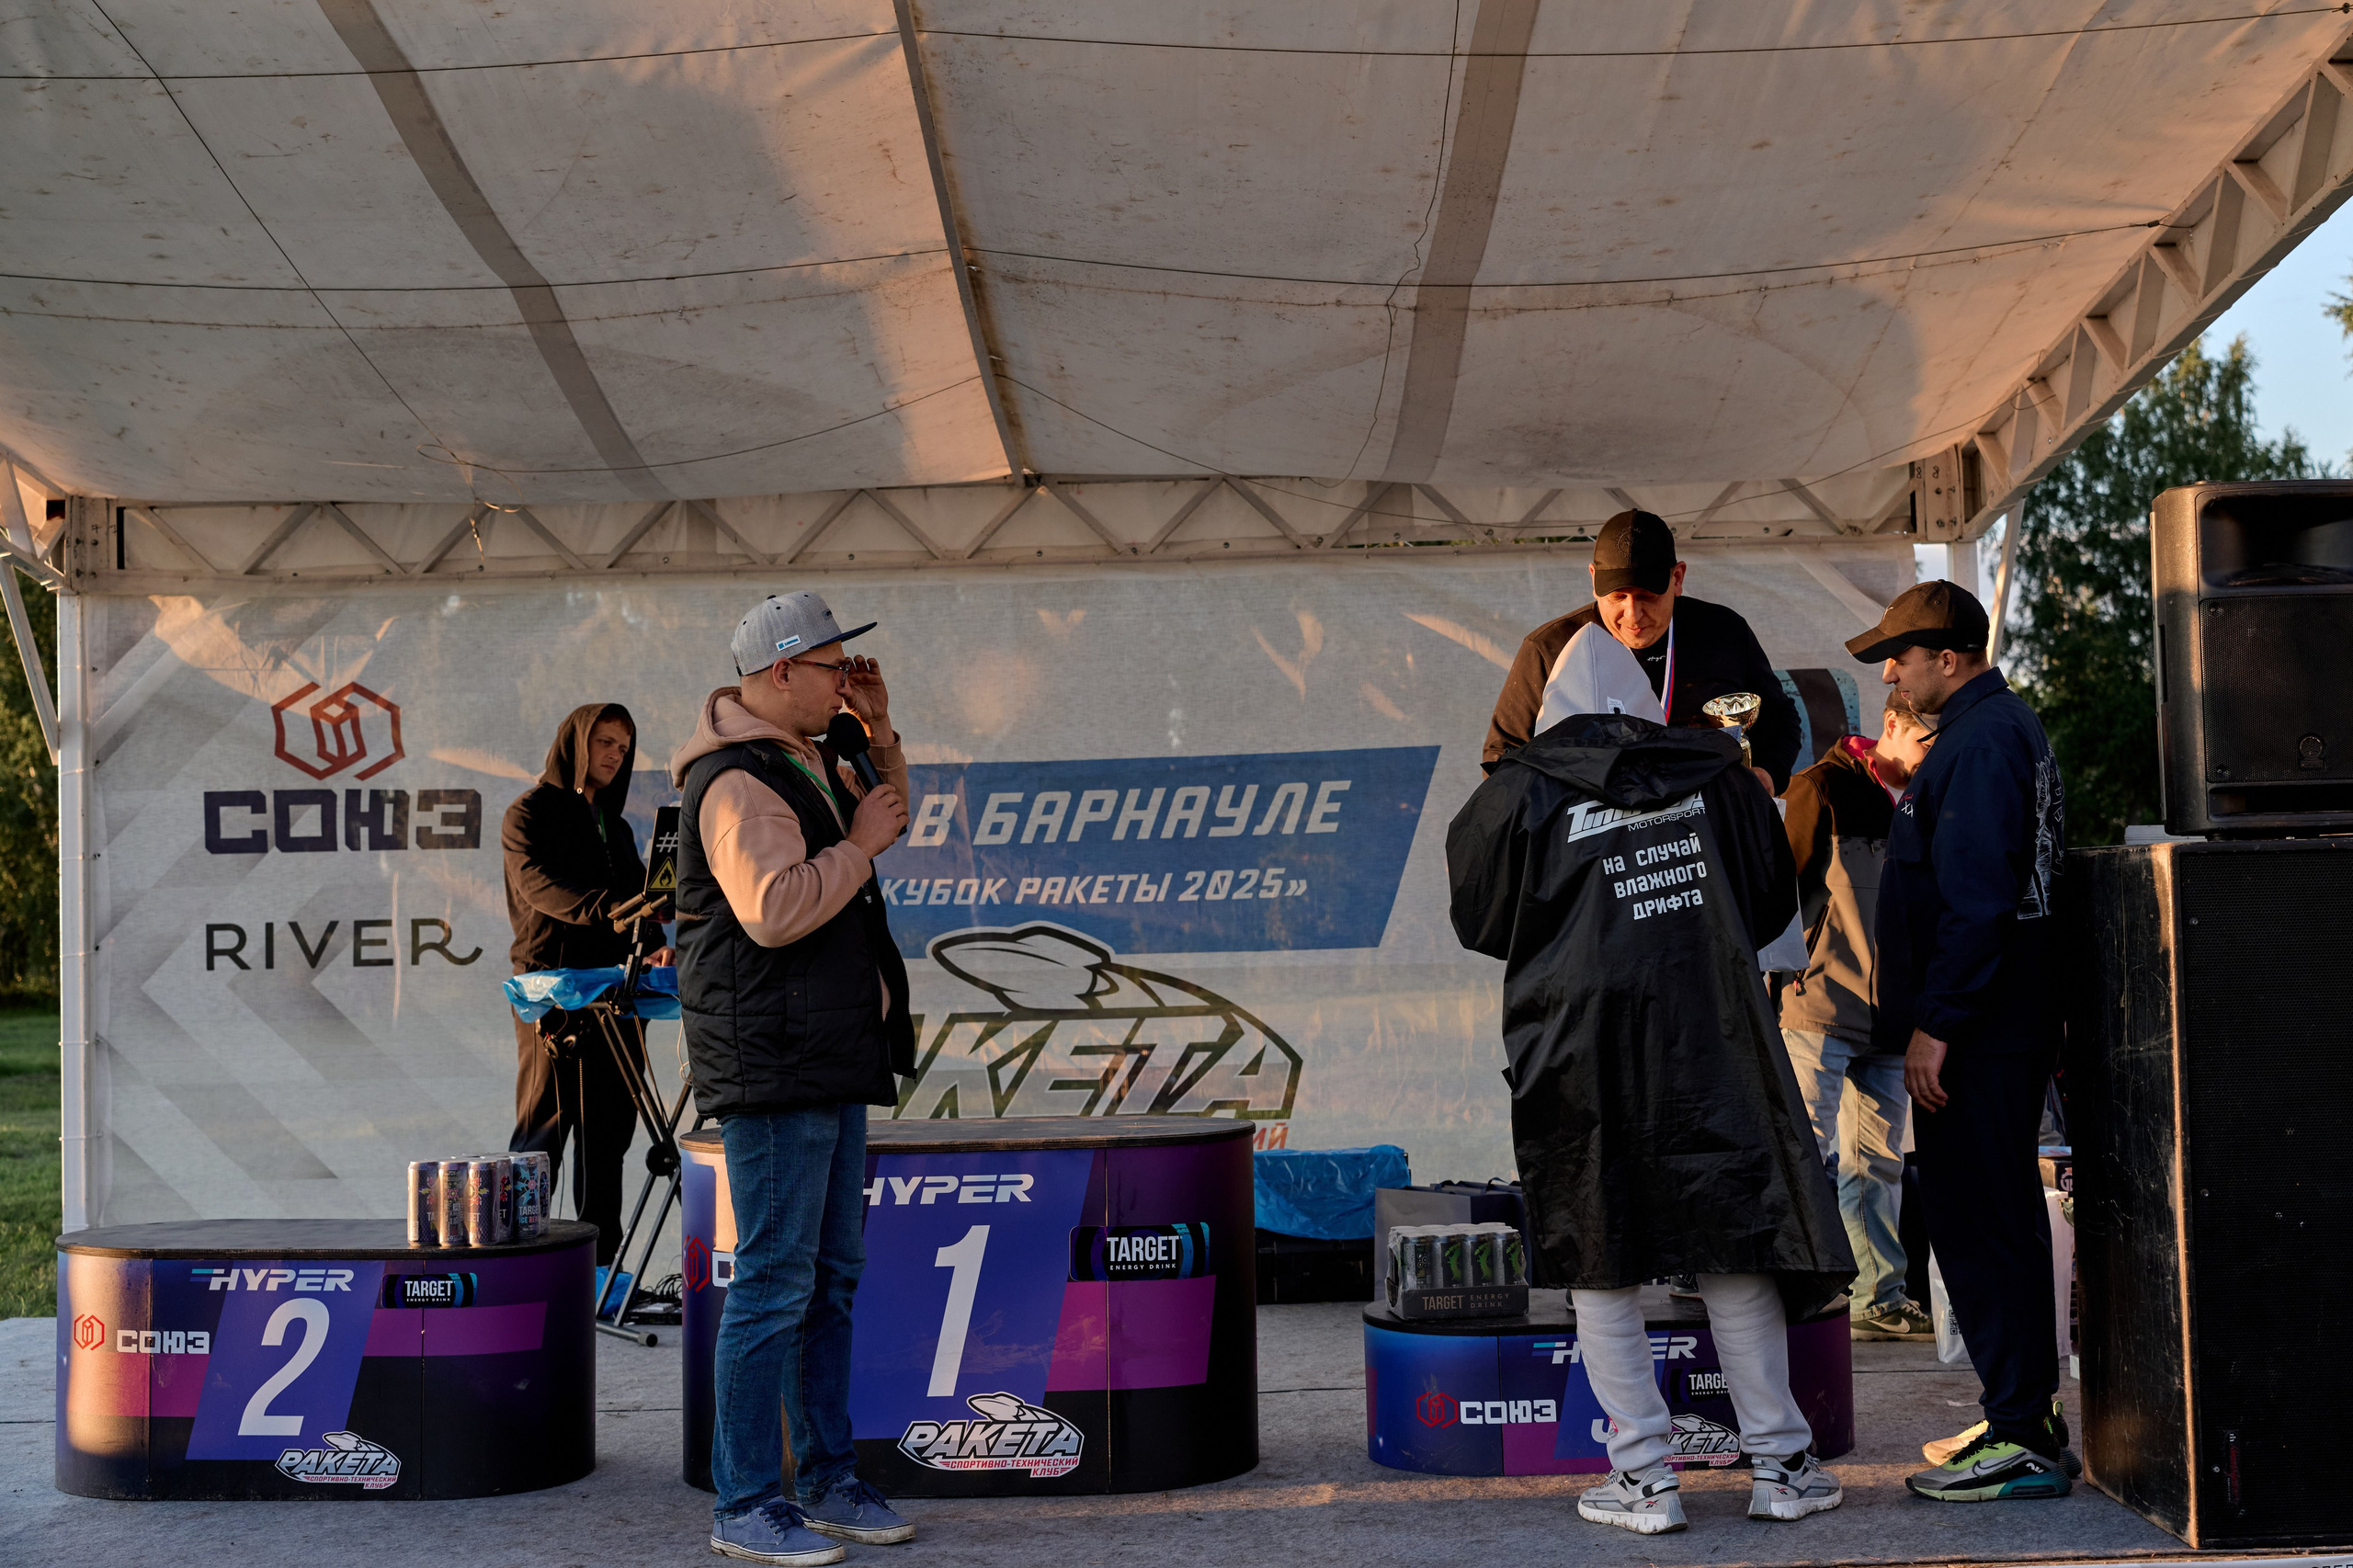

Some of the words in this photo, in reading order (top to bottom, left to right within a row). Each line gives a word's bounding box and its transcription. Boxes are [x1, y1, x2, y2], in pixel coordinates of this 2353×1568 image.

[204, 789, 482, 854] СОЮЗ
[907, 794, 958, 847] В
[972, 779, 1352, 846] БАРНАУЛЕ
[1627, 807, 1706, 832] MOTORSPORT
[881, 877, 1007, 906] КУБОК
[1014, 872, 1174, 905] РАКЕТЫ
[1178, 867, 1308, 902] 2025»
[205, 918, 483, 971] RIVER
[1107, 1235, 1179, 1262] TARGET
[202, 1268, 354, 1291] HYPER
[404, 1280, 453, 1297] TARGET
[1423, 1295, 1464, 1311] TARGET
[1471, 1292, 1510, 1301] ENERGY
[926, 1225, 990, 1397] 1
[117, 1330, 210, 1354] СОЮЗ
[237, 1297, 330, 1436] 2
[1688, 1373, 1729, 1390] TARGE
[1460, 1399, 1557, 1424] СОЮЗ
[903, 1422, 1079, 1457] РАКЕТА
[278, 1451, 397, 1474] РАКЕТА
[950, 1457, 1079, 1469] СПОРТИВНО-ТЕХНИЧЕСКИЙ
[1664, 1452, 1739, 1462] ПОРТИВНО-ТЕХНИЧЕСКИЙ
[309, 1474, 397, 1483] СПОРТИВНО-ТЕХНИЧЕСКИЙ
[1031, 1468, 1060, 1476] КЛУБ
